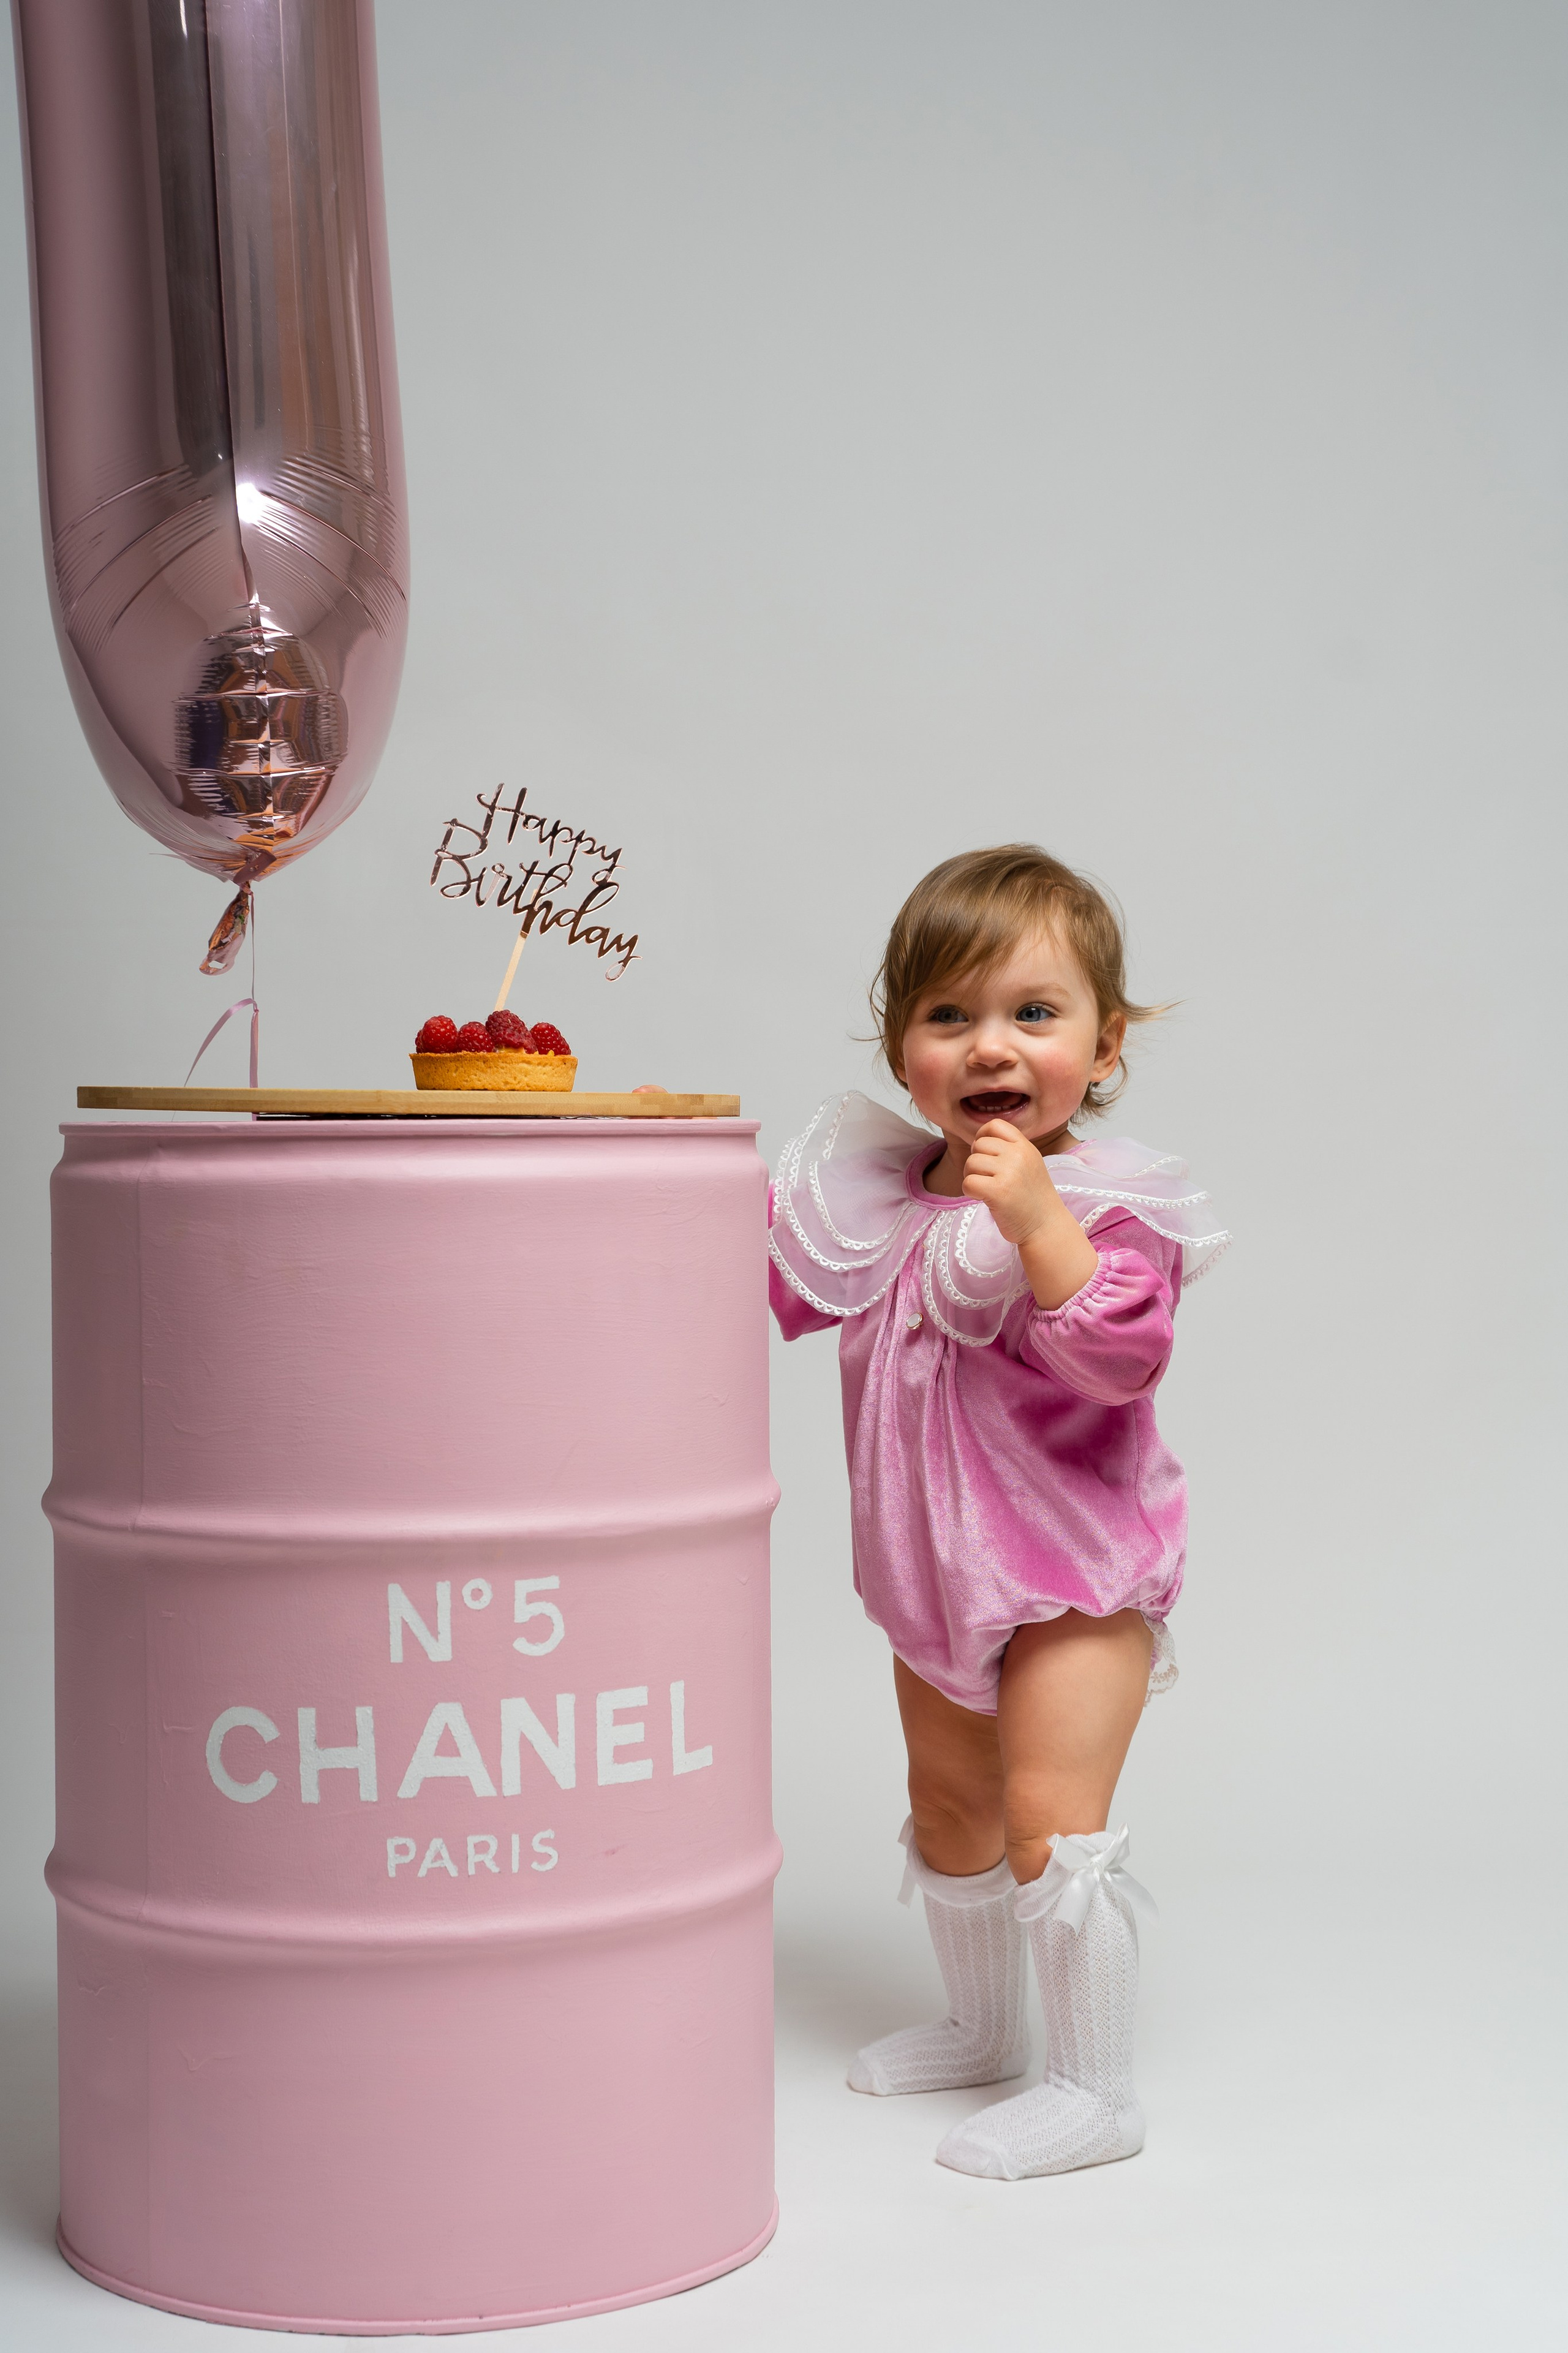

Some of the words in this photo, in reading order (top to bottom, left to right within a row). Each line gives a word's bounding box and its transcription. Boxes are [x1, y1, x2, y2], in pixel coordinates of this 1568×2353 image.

[476, 782, 627, 884] Happy
[430, 818, 643, 981] Birthday
[206, 1680, 713, 1804] CHANEL
[386, 1829, 559, 1878] PARIS
